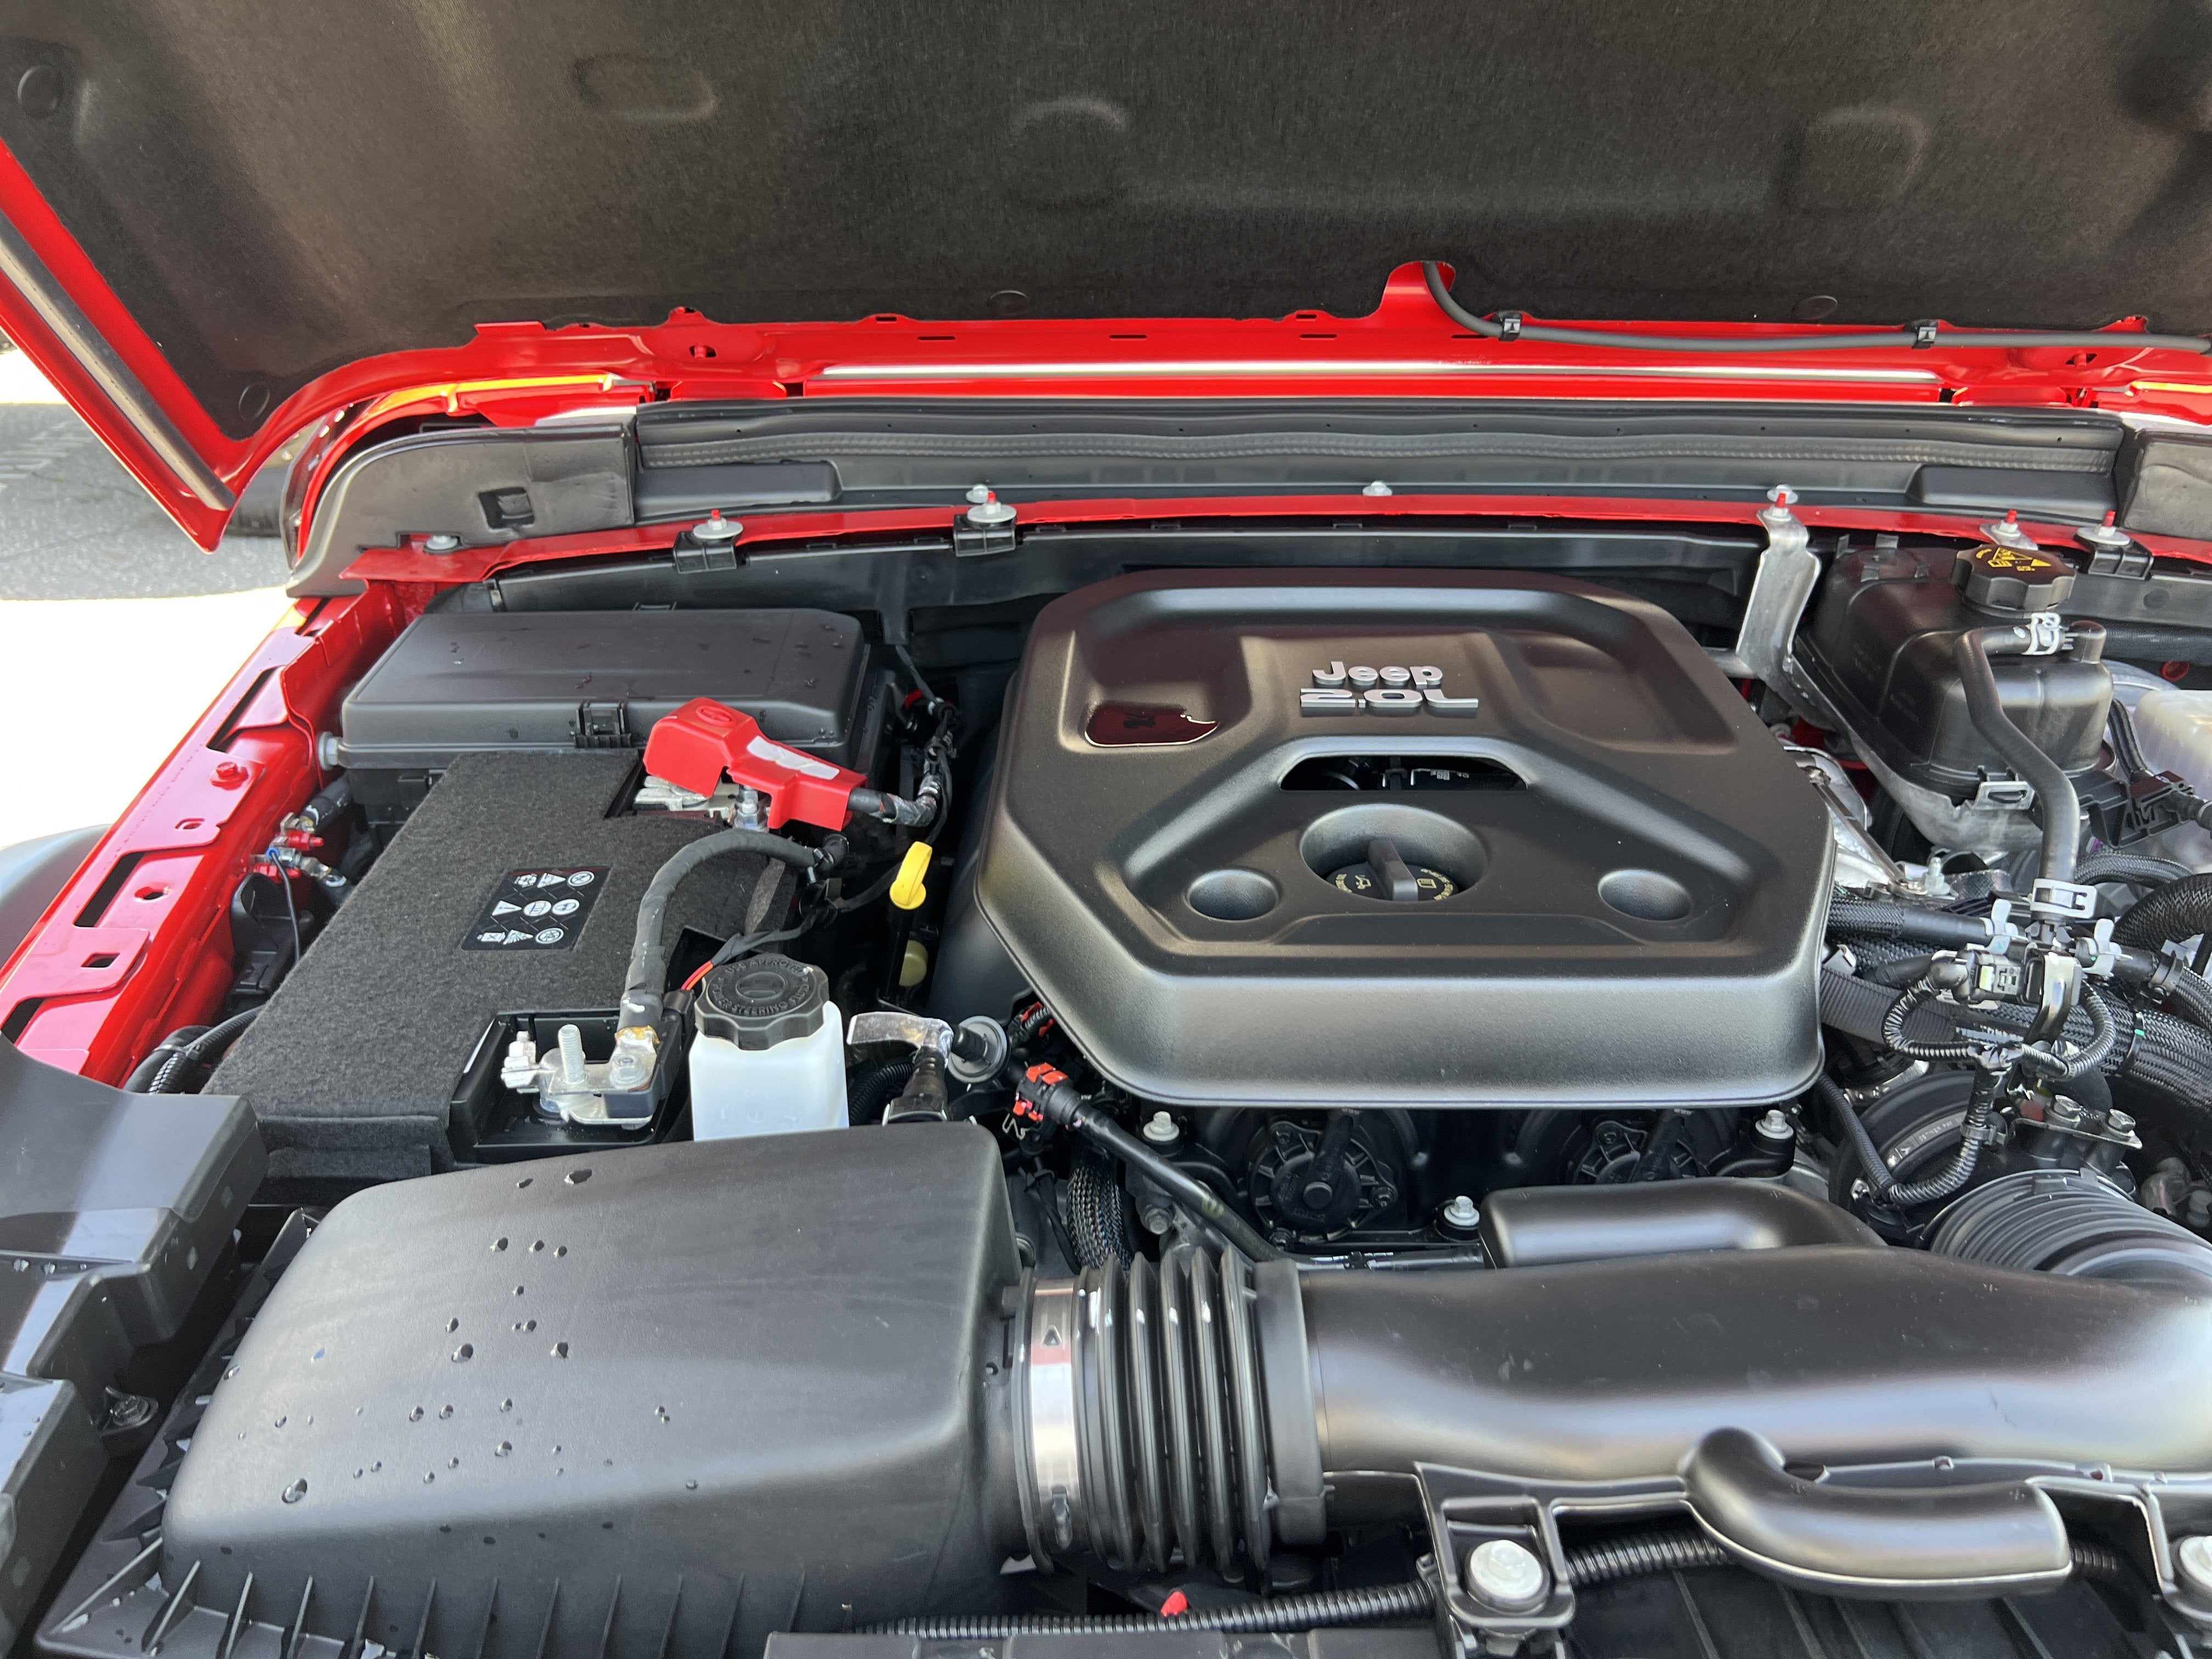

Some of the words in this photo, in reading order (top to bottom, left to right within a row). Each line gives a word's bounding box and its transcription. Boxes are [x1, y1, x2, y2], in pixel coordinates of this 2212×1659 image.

[1312, 661, 1443, 689] Jeep
[1300, 688, 1478, 708] 2.0L
[724, 963, 747, 974] USE
[732, 1001, 788, 1017] STEERING
